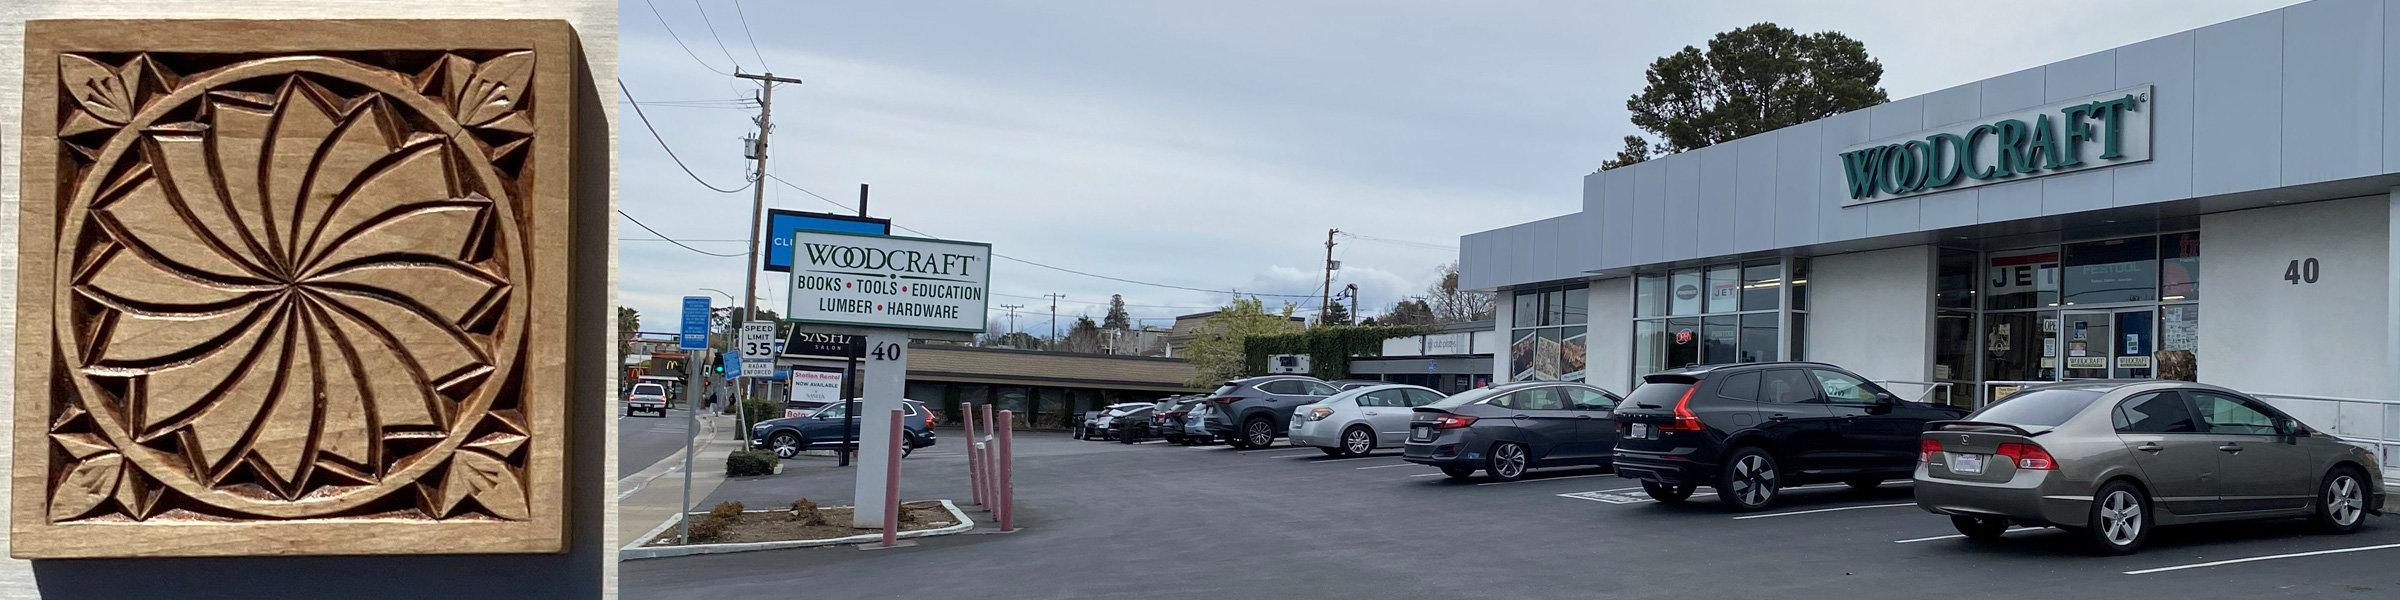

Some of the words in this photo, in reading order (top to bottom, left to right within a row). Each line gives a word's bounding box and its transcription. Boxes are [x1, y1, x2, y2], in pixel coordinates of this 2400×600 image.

[1993, 263, 2058, 287] JET
[2284, 257, 2319, 284] 40
[798, 275, 841, 292] BOOKS
[856, 279, 897, 295] TOOLS
[912, 283, 981, 300] EDUCATION
[1714, 288, 1733, 296] JET
[819, 297, 873, 314] LUMBER
[887, 302, 958, 319] HARDWARE
[2045, 320, 2057, 330] OPE
[745, 342, 771, 356] 35
[871, 341, 901, 361] 40
